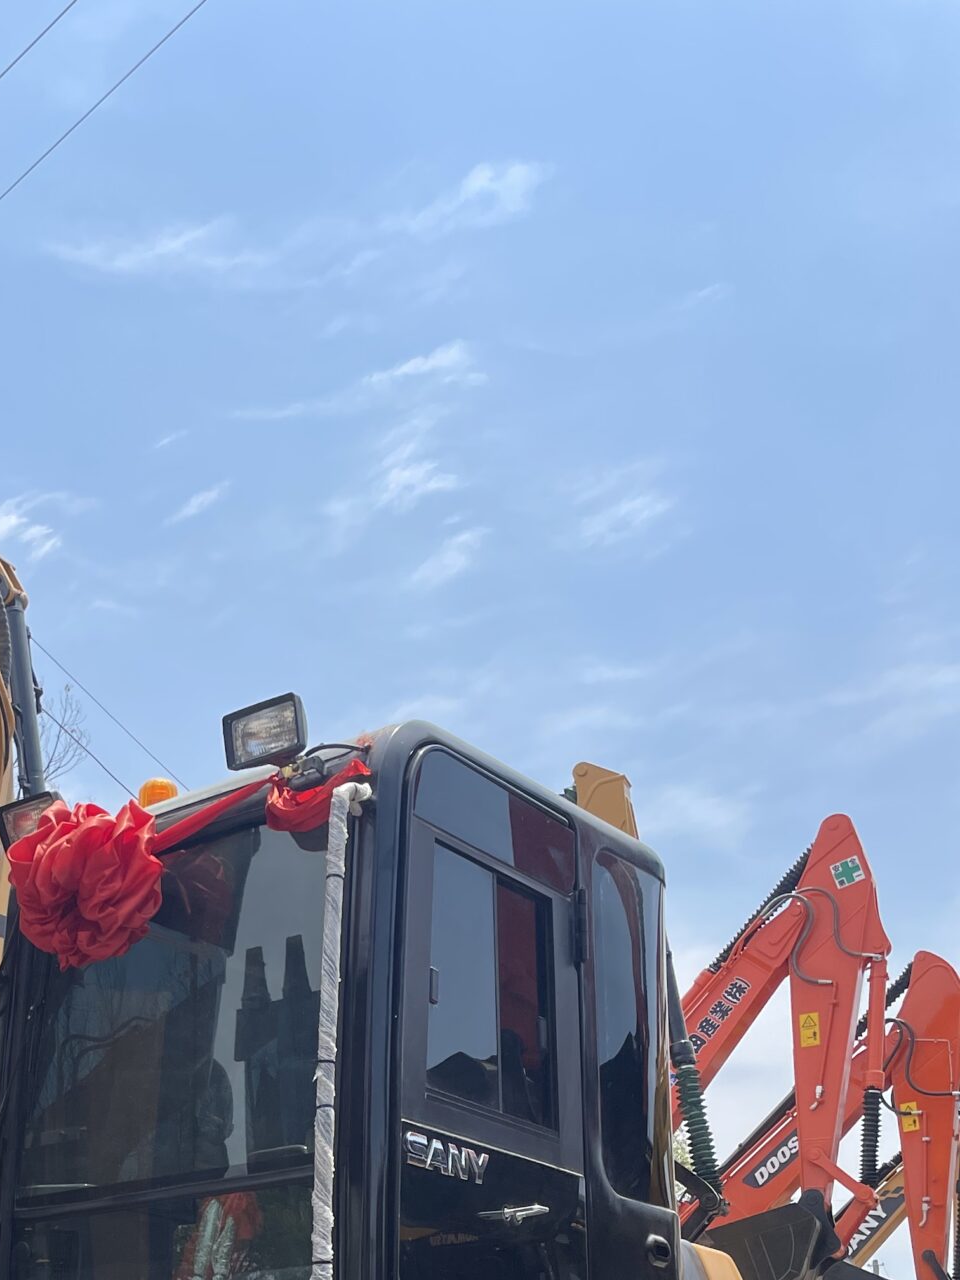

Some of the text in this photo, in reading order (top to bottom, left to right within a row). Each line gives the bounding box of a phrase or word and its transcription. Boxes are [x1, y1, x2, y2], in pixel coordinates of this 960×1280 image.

[404, 1131, 489, 1184] SANY
[754, 1136, 799, 1186] DOOS
[847, 1203, 887, 1256] ANY
